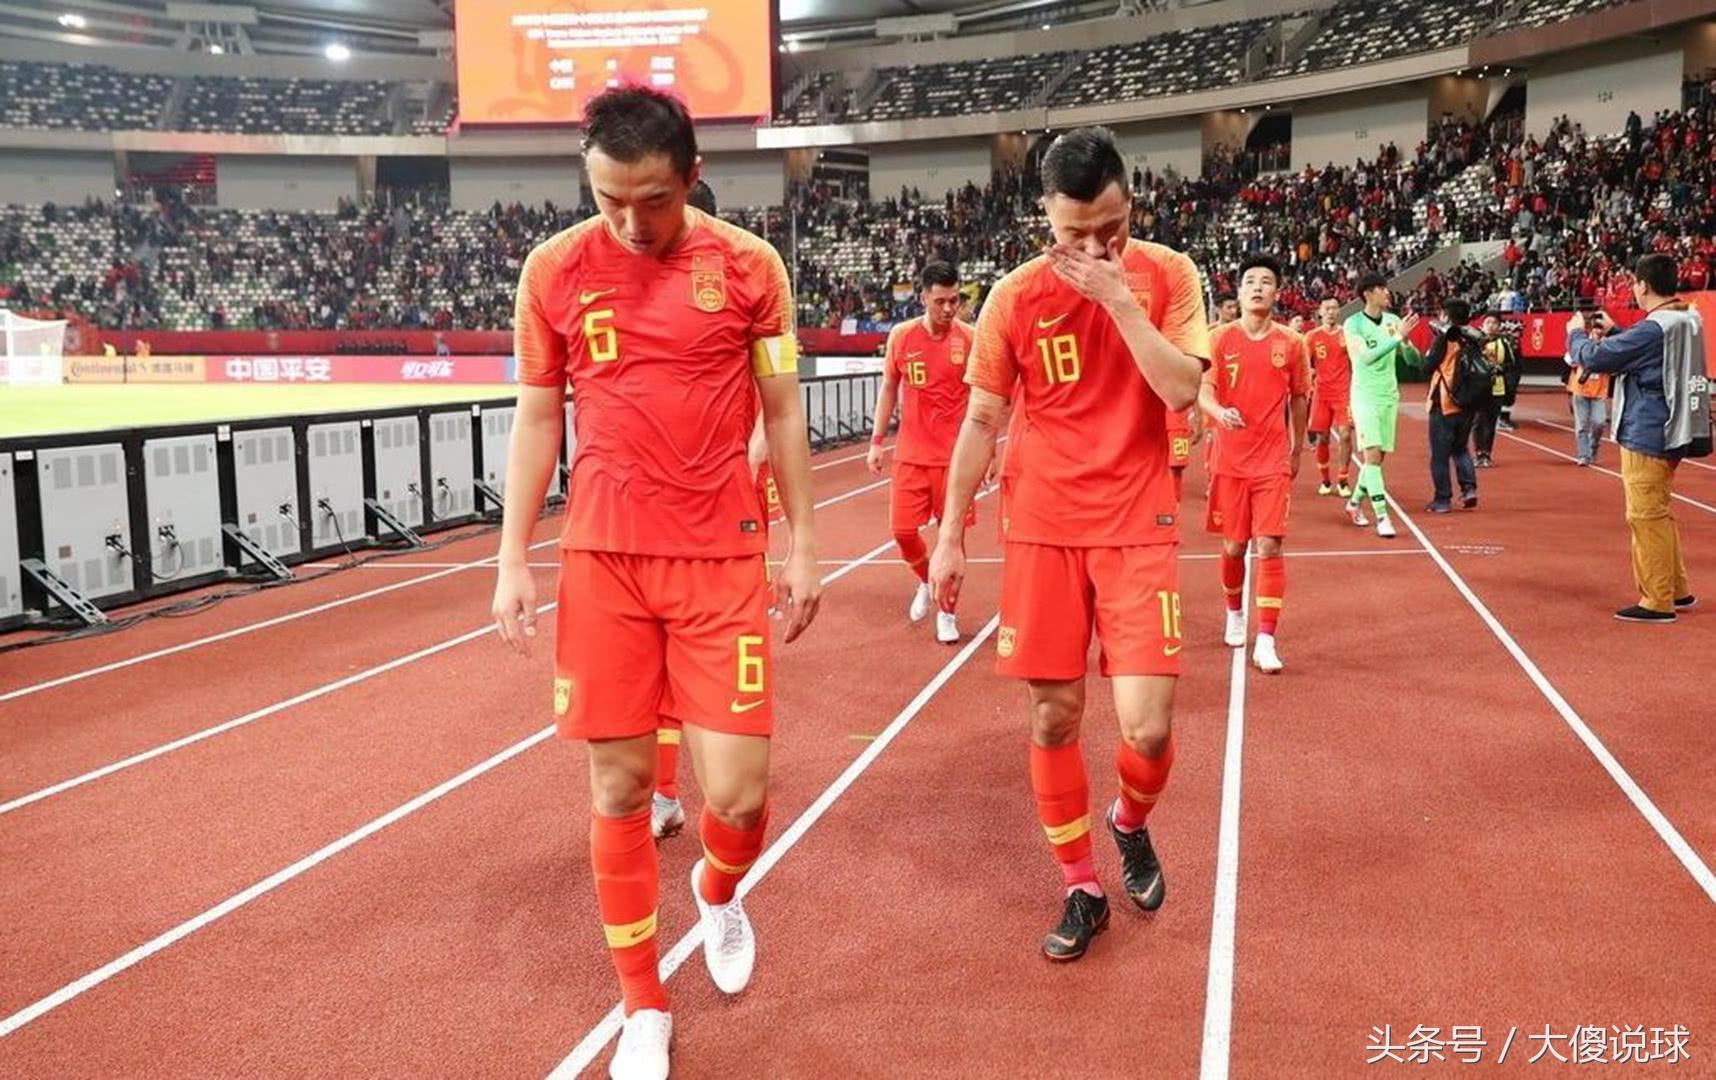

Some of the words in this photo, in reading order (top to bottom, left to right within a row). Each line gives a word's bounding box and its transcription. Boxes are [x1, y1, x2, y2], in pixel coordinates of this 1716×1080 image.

[585, 308, 618, 362] 6
[226, 358, 331, 381] 中国平安
[1037, 333, 1080, 384] 18
[906, 361, 926, 385] 16
[1226, 363, 1239, 388] 7
[1173, 438, 1189, 455] 20
[738, 635, 764, 692] 6
